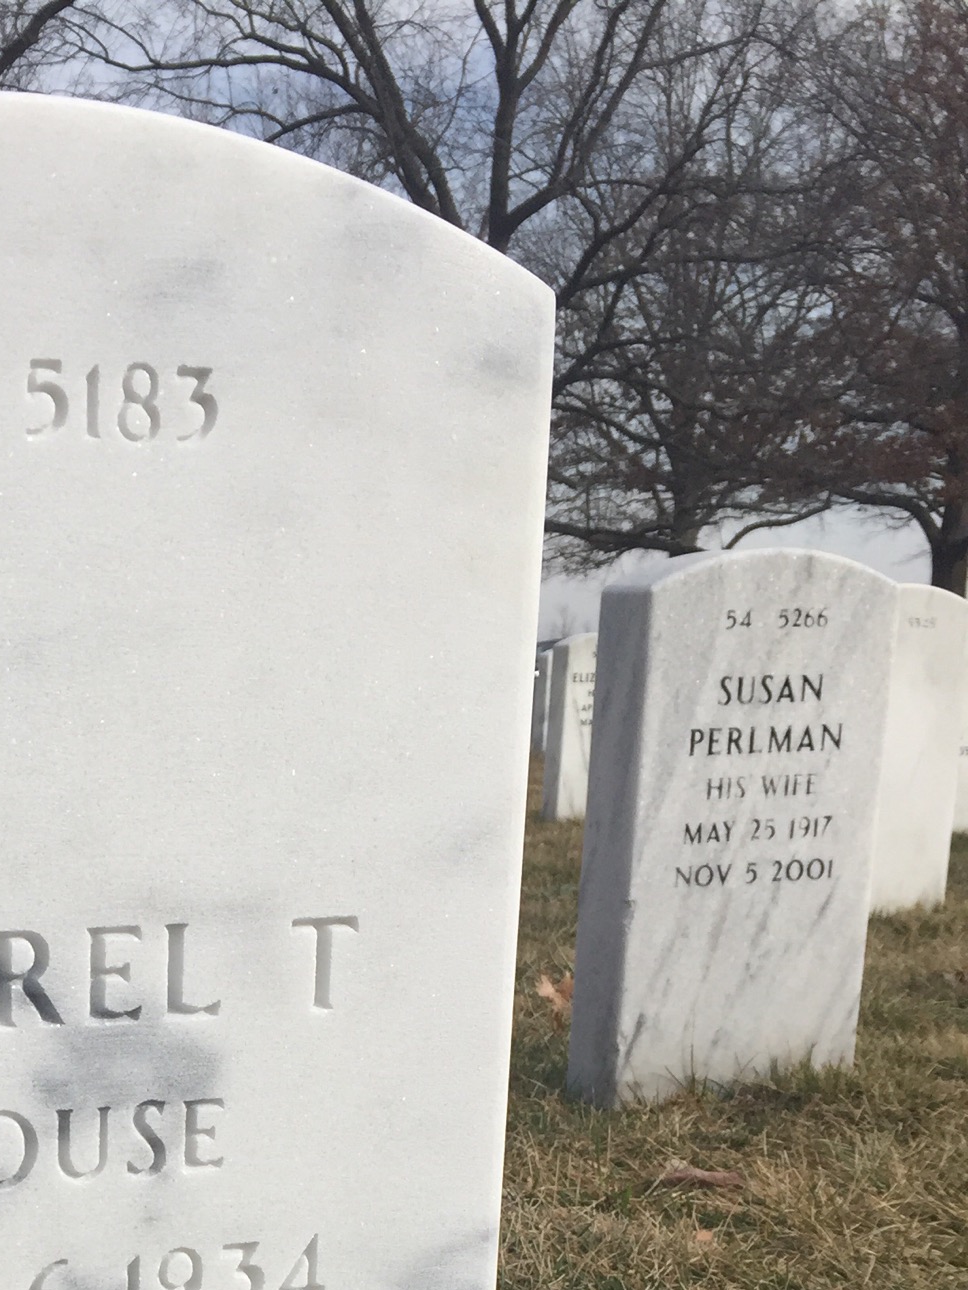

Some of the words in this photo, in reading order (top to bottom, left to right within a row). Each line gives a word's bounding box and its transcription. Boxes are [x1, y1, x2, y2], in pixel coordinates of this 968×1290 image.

[26, 357, 219, 443] 5183
[725, 608, 753, 630] 54
[778, 607, 829, 629] 5266
[717, 673, 824, 706] SUSAN
[688, 722, 843, 757] PERLMAN
[706, 776, 746, 801] HIS
[761, 773, 817, 799] WIFE
[683, 819, 736, 846] MAY
[750, 817, 776, 841] 25
[789, 815, 833, 840] 1917
[674, 862, 733, 888] NOV
[746, 862, 758, 884] 5
[772, 857, 833, 882] 2001
[292, 914, 360, 1012] T
